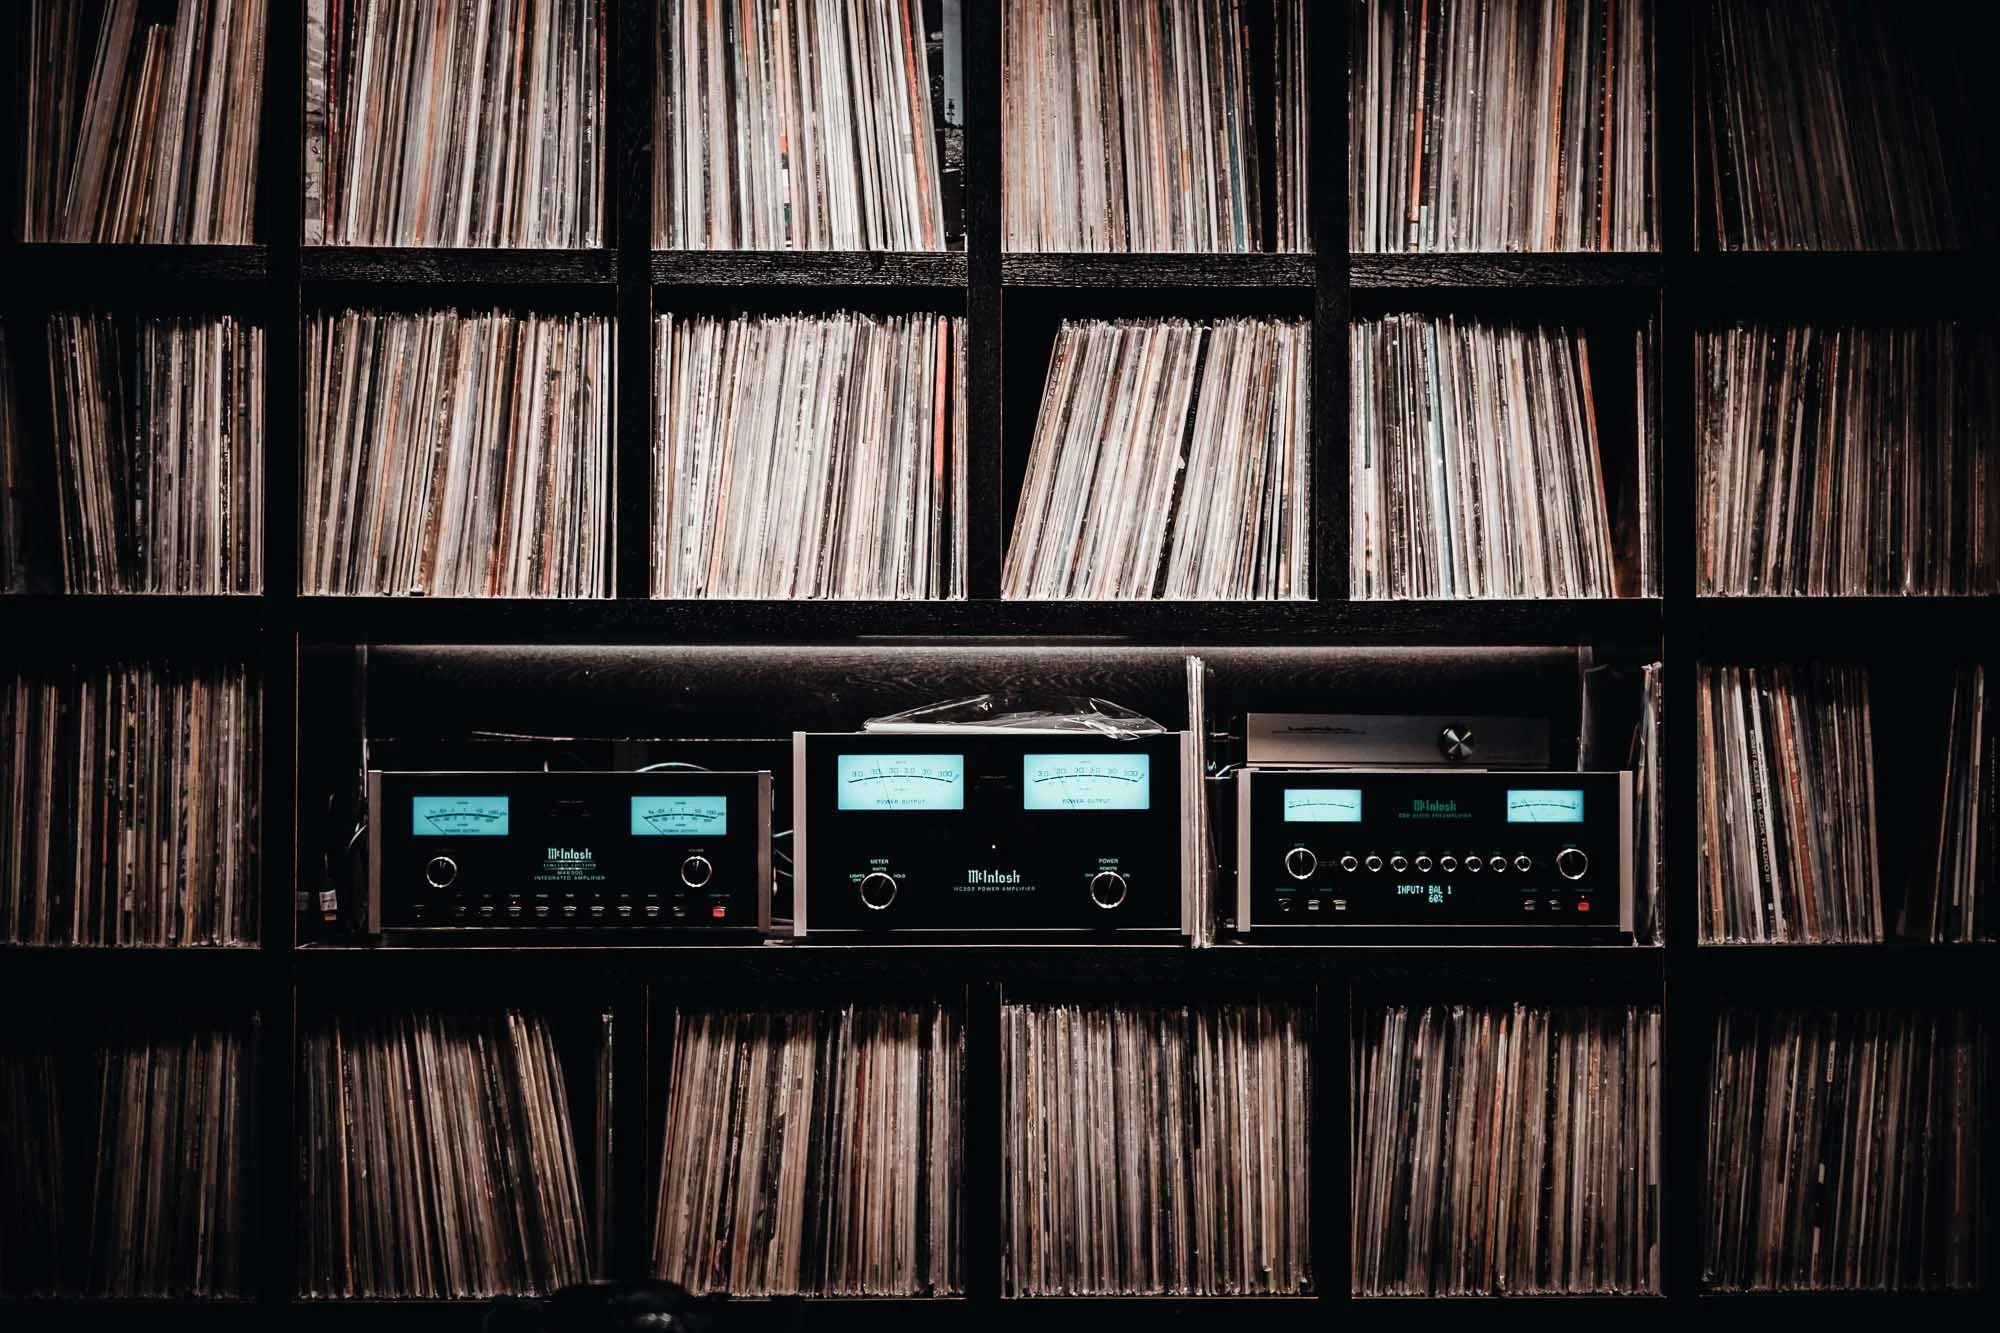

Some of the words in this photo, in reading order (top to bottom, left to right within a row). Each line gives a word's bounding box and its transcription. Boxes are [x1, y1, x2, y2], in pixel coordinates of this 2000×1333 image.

[1414, 800, 1456, 812] McIntosh
[1756, 798, 1765, 834] BLACK
[1762, 837, 1770, 871] RADIO
[547, 848, 592, 860] McIntosh
[968, 870, 1021, 884] McIntosh
[1396, 884, 1424, 894] INPUT:
[1428, 884, 1444, 894] BAL
[1447, 884, 1452, 894] 1
[1428, 894, 1444, 904] 60%
